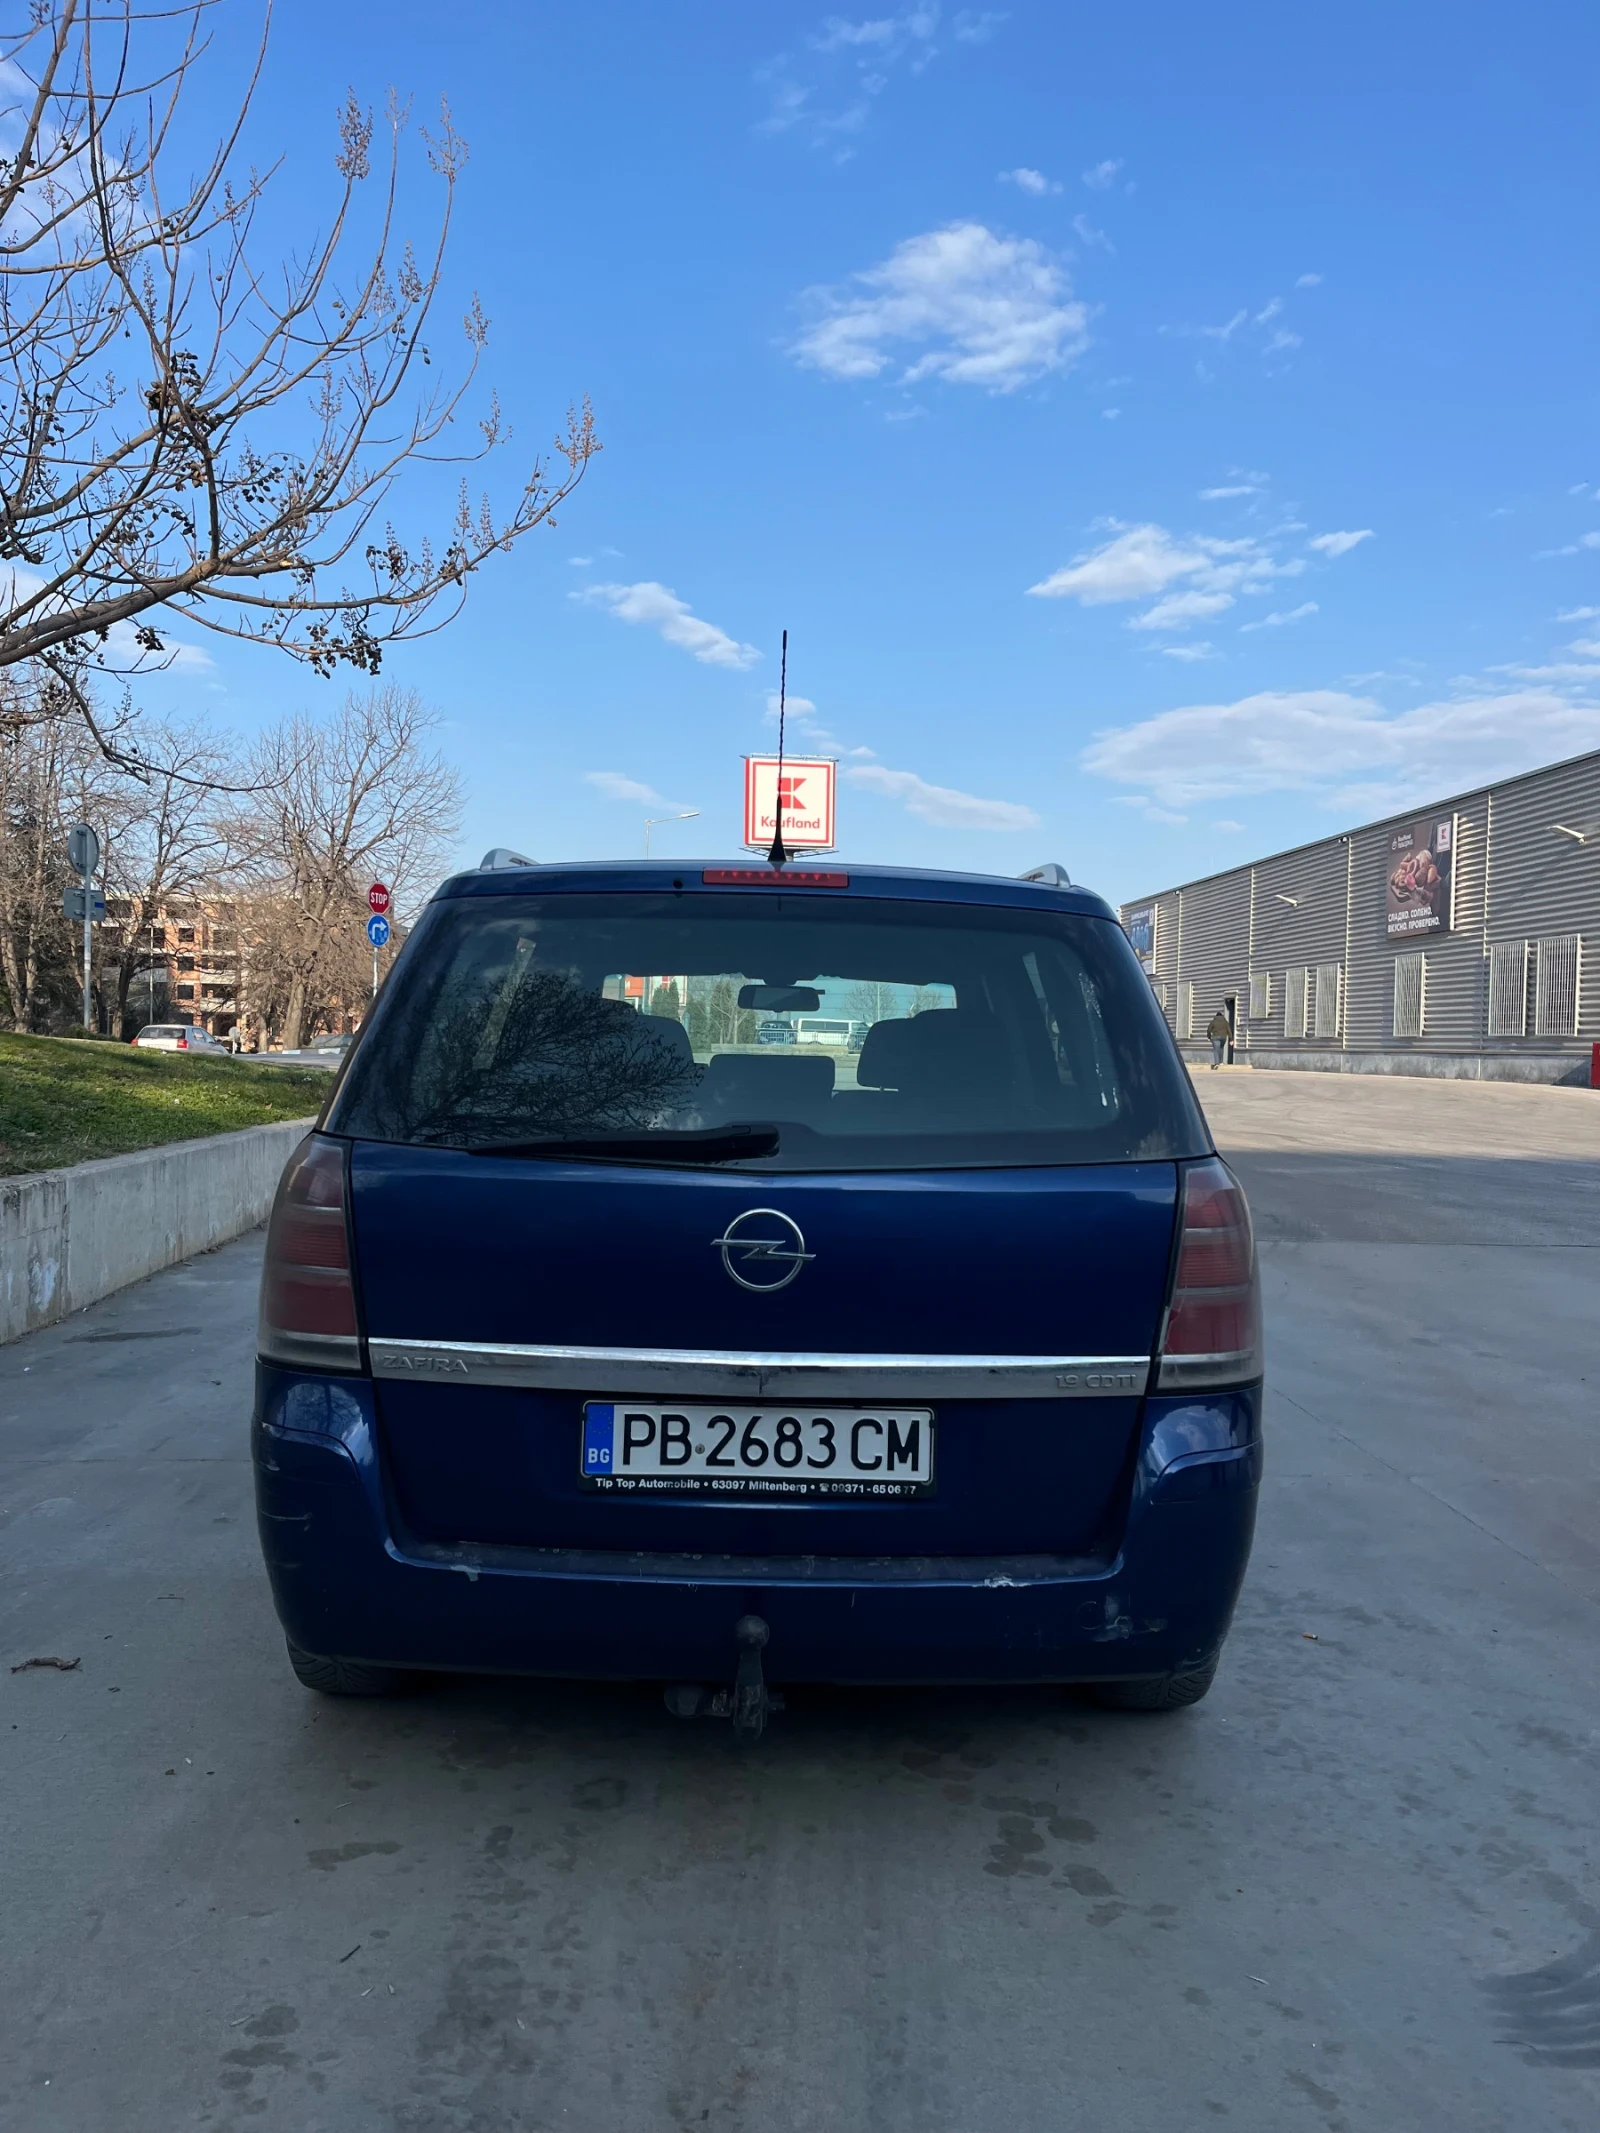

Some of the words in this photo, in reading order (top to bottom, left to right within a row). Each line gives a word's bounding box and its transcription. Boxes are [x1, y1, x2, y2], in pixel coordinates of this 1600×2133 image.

[761, 816, 820, 829] Kaufland
[370, 892, 388, 905] STOP
[1410, 906, 1433, 918] СОЛЕНО.
[1387, 922, 1408, 933] ВКУСНО.
[1408, 916, 1441, 930] ПРОВЕРЕНО.
[383, 1355, 468, 1373] ZAFIRA
[1085, 1374, 1137, 1389] CDTI
[622, 1413, 691, 1466] PB
[705, 1415, 837, 1469] 2683
[851, 1419, 920, 1472] CM
[588, 1448, 610, 1464] BG
[596, 1478, 613, 1489] Tip
[616, 1478, 636, 1490] Top
[749, 1480, 807, 1493] Miltenberg
